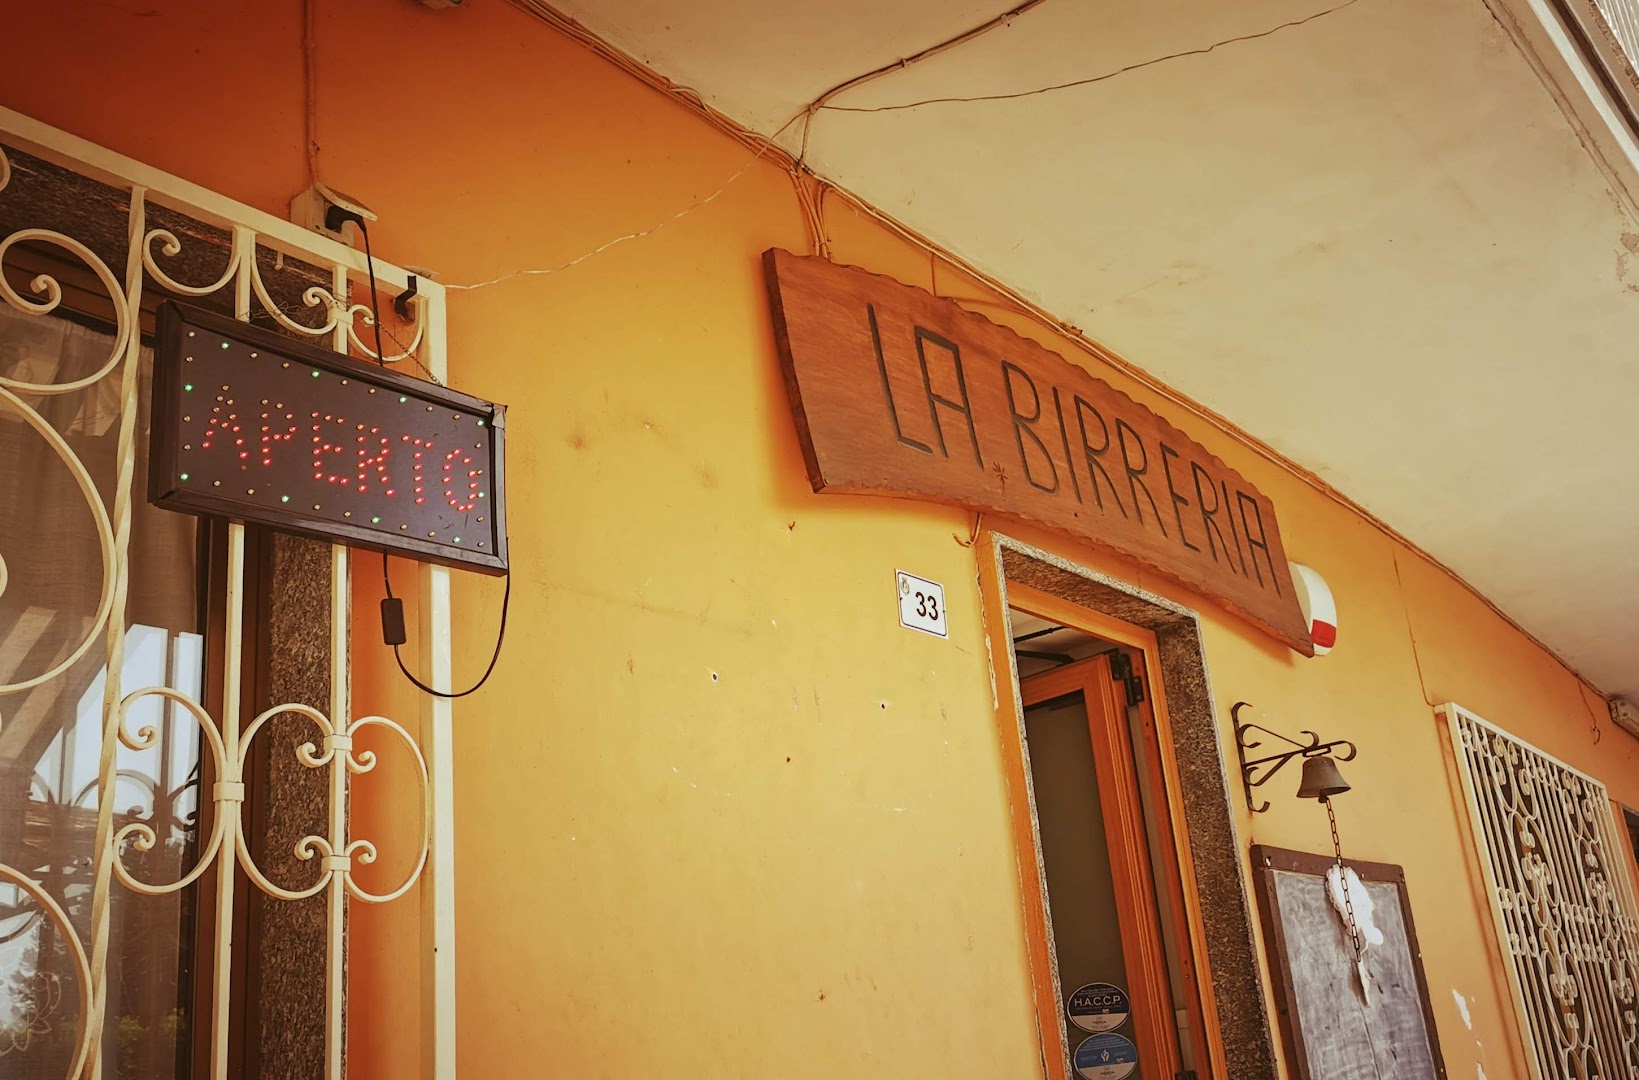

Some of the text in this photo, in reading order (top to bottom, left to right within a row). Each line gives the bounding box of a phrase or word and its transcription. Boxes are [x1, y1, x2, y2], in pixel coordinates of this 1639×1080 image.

[201, 384, 479, 512] APERTO
[866, 302, 1283, 599] LA BIRRERIA
[915, 591, 939, 621] 33
